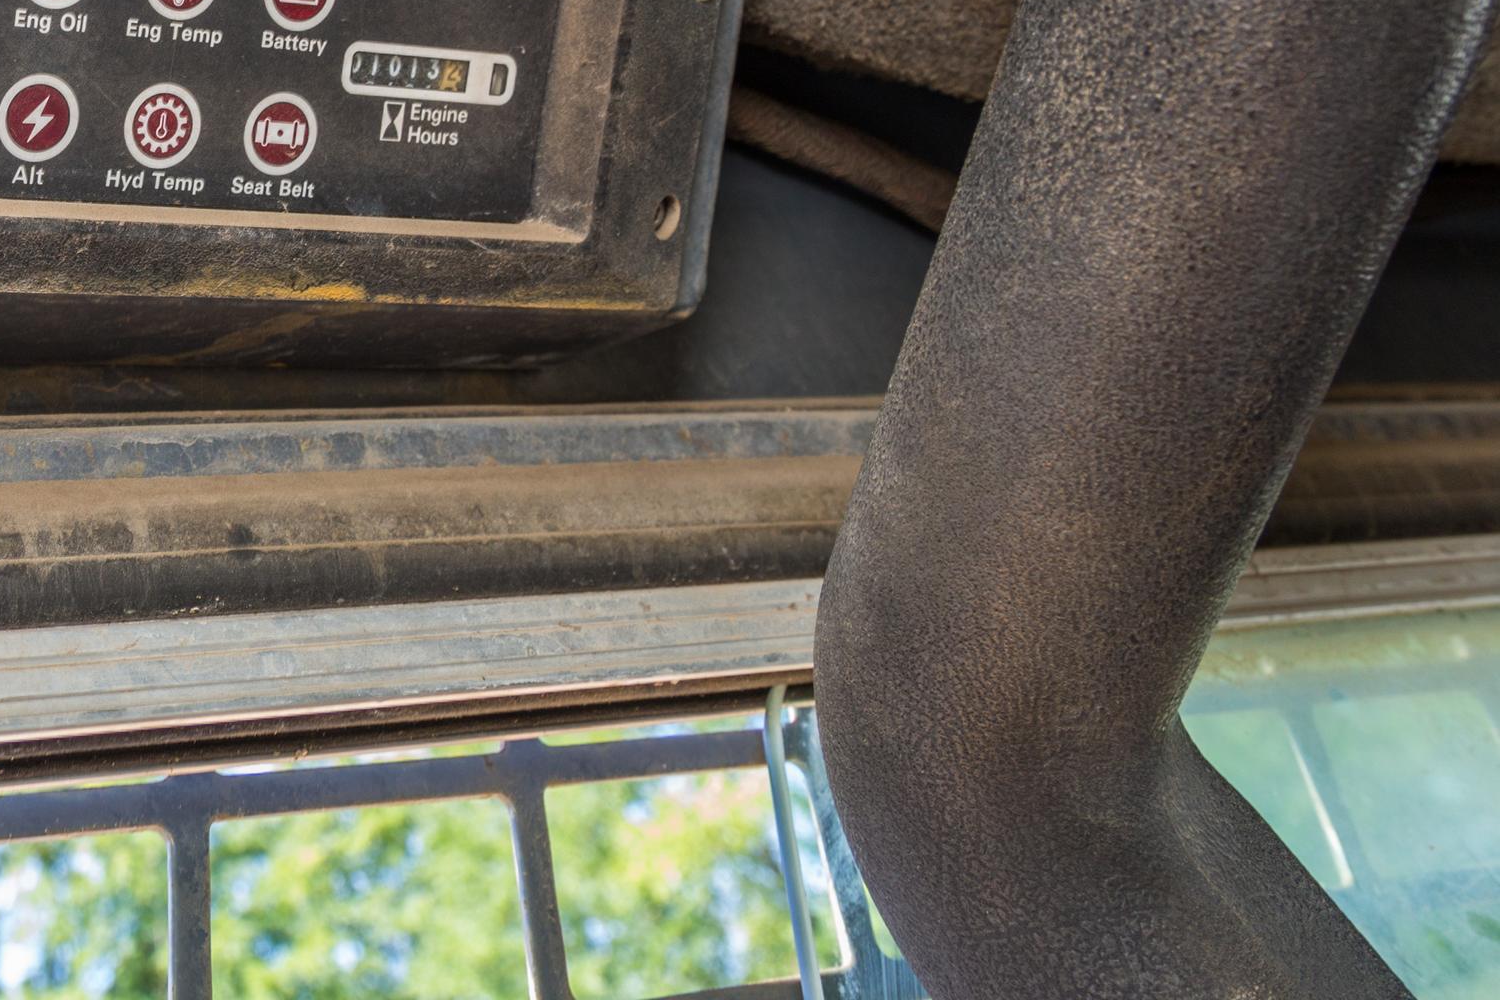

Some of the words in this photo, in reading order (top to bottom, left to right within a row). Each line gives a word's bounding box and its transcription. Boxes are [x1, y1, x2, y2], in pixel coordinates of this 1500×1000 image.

[14, 8, 52, 34] Eng
[60, 12, 88, 33] Oil
[126, 17, 162, 43] Eng
[170, 23, 223, 47] Temp
[261, 30, 328, 57] Battery
[410, 103, 468, 126] Engine
[407, 125, 459, 146] Hours
[11, 165, 45, 185] Alt
[105, 169, 145, 192] Hyd
[151, 171, 205, 195] Temp
[231, 176, 272, 196] Seat
[279, 180, 315, 198] Belt
